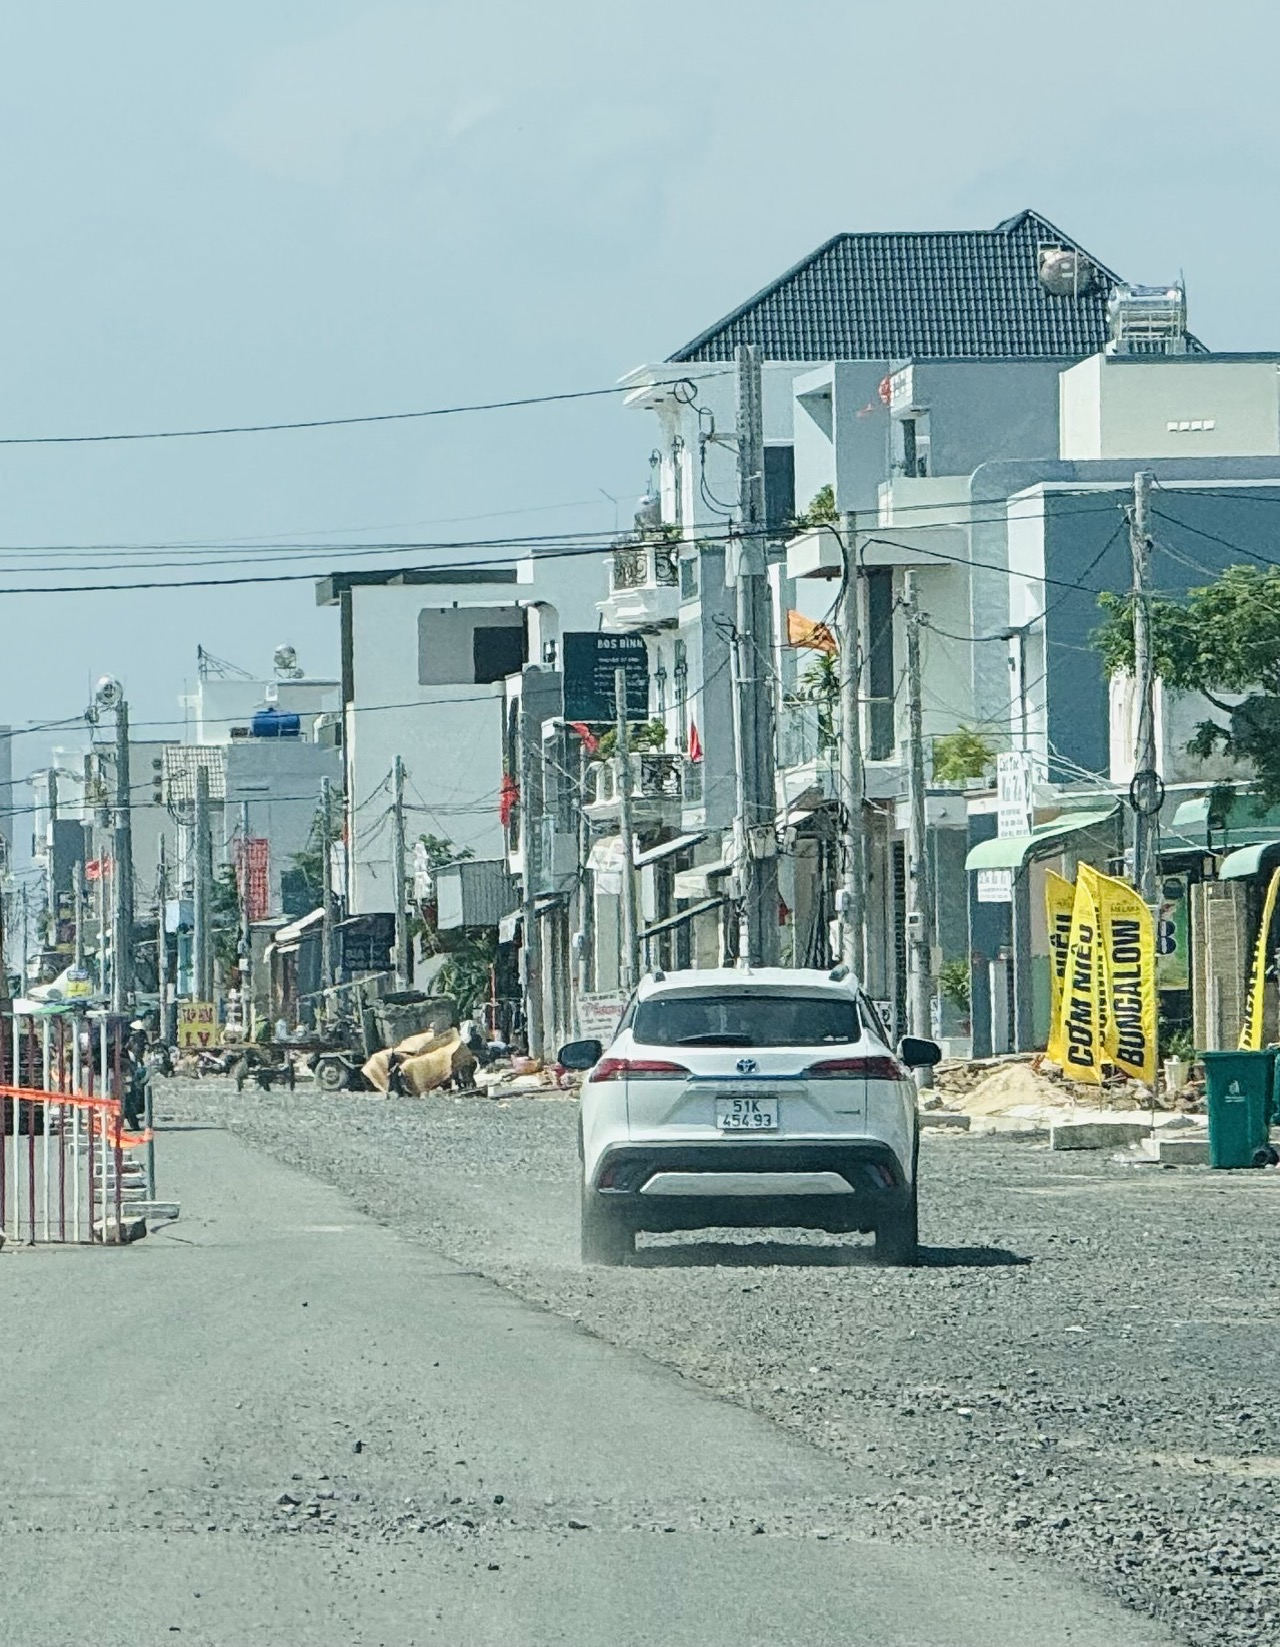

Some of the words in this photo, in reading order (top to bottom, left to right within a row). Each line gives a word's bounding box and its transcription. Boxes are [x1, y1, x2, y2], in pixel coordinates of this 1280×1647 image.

[1071, 924, 1094, 993] NIÊU
[1111, 919, 1145, 1068] BUNGALOW
[1064, 997, 1094, 1067] CƠM
[733, 1100, 760, 1113] 51K
